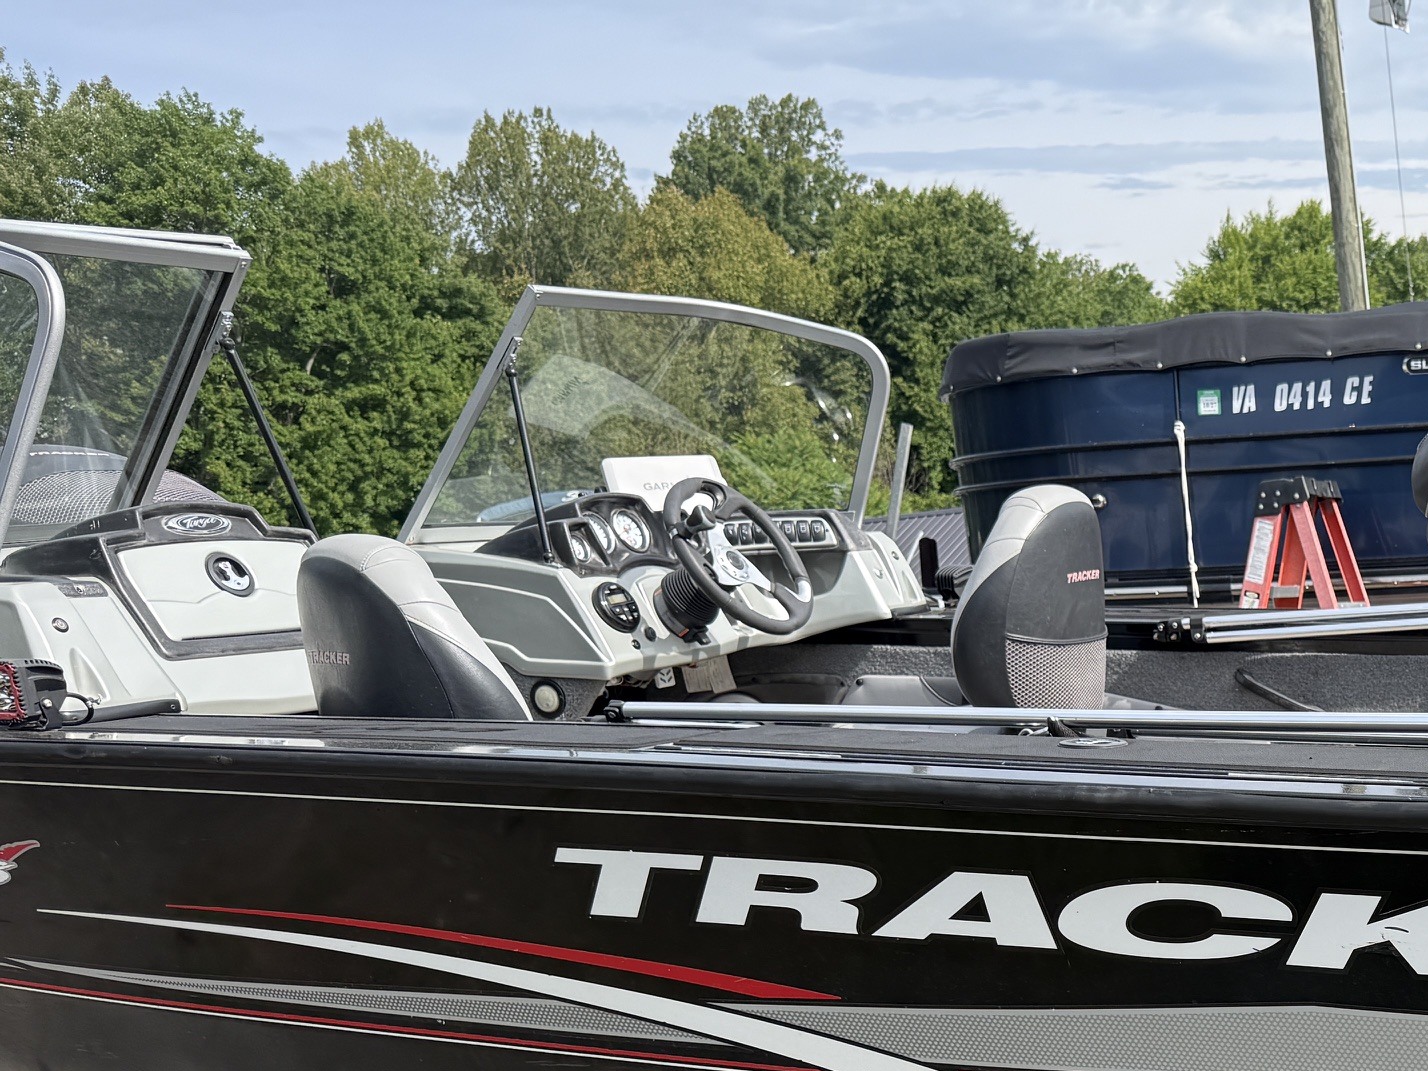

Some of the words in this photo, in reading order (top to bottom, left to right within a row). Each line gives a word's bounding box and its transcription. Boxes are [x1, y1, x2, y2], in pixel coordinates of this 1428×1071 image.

[1232, 384, 1256, 413] VA
[1274, 379, 1332, 412] 0414
[1343, 375, 1373, 404] CE
[643, 482, 674, 491] GAR
[1066, 569, 1100, 584] TRACKER
[307, 650, 350, 665] TRACKER
